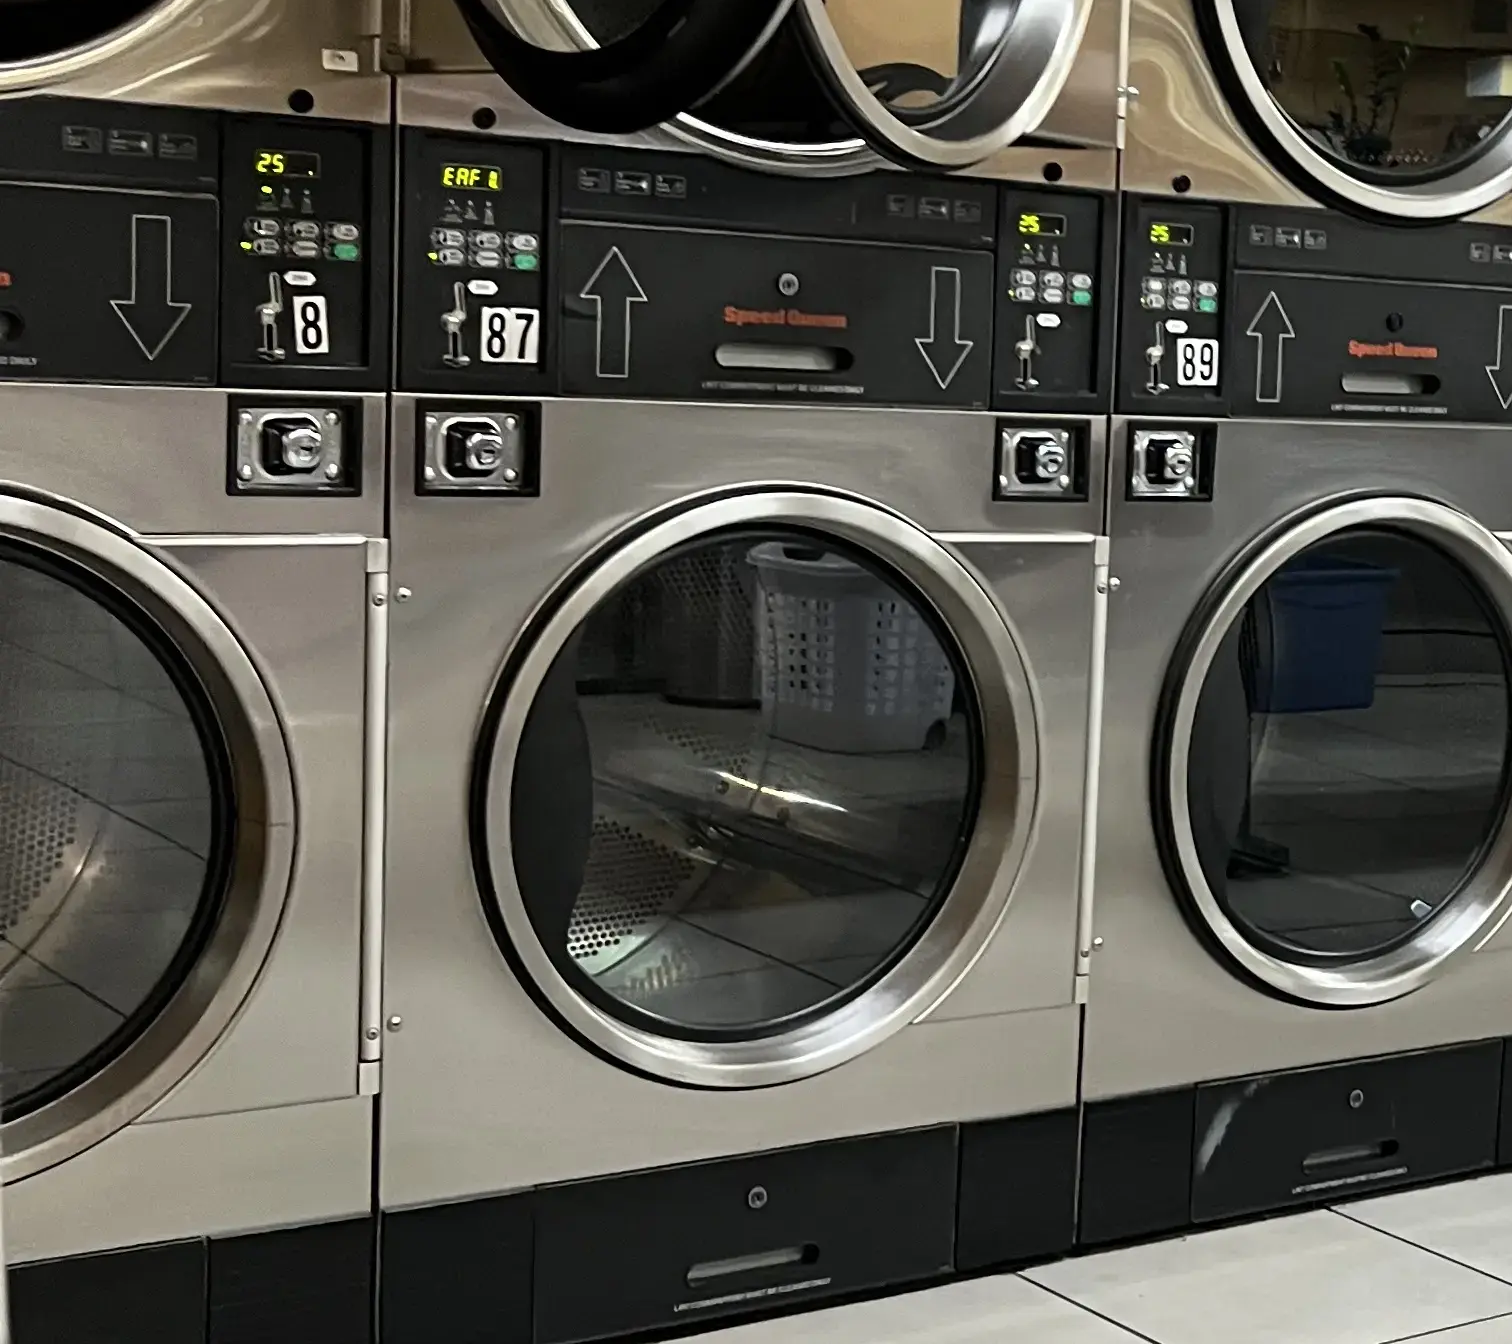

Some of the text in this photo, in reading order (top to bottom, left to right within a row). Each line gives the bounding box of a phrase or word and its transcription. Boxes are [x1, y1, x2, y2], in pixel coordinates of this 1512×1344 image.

[257, 153, 284, 173] 25
[300, 301, 323, 350] 8
[486, 312, 535, 360] 87
[1182, 342, 1214, 381] 89
